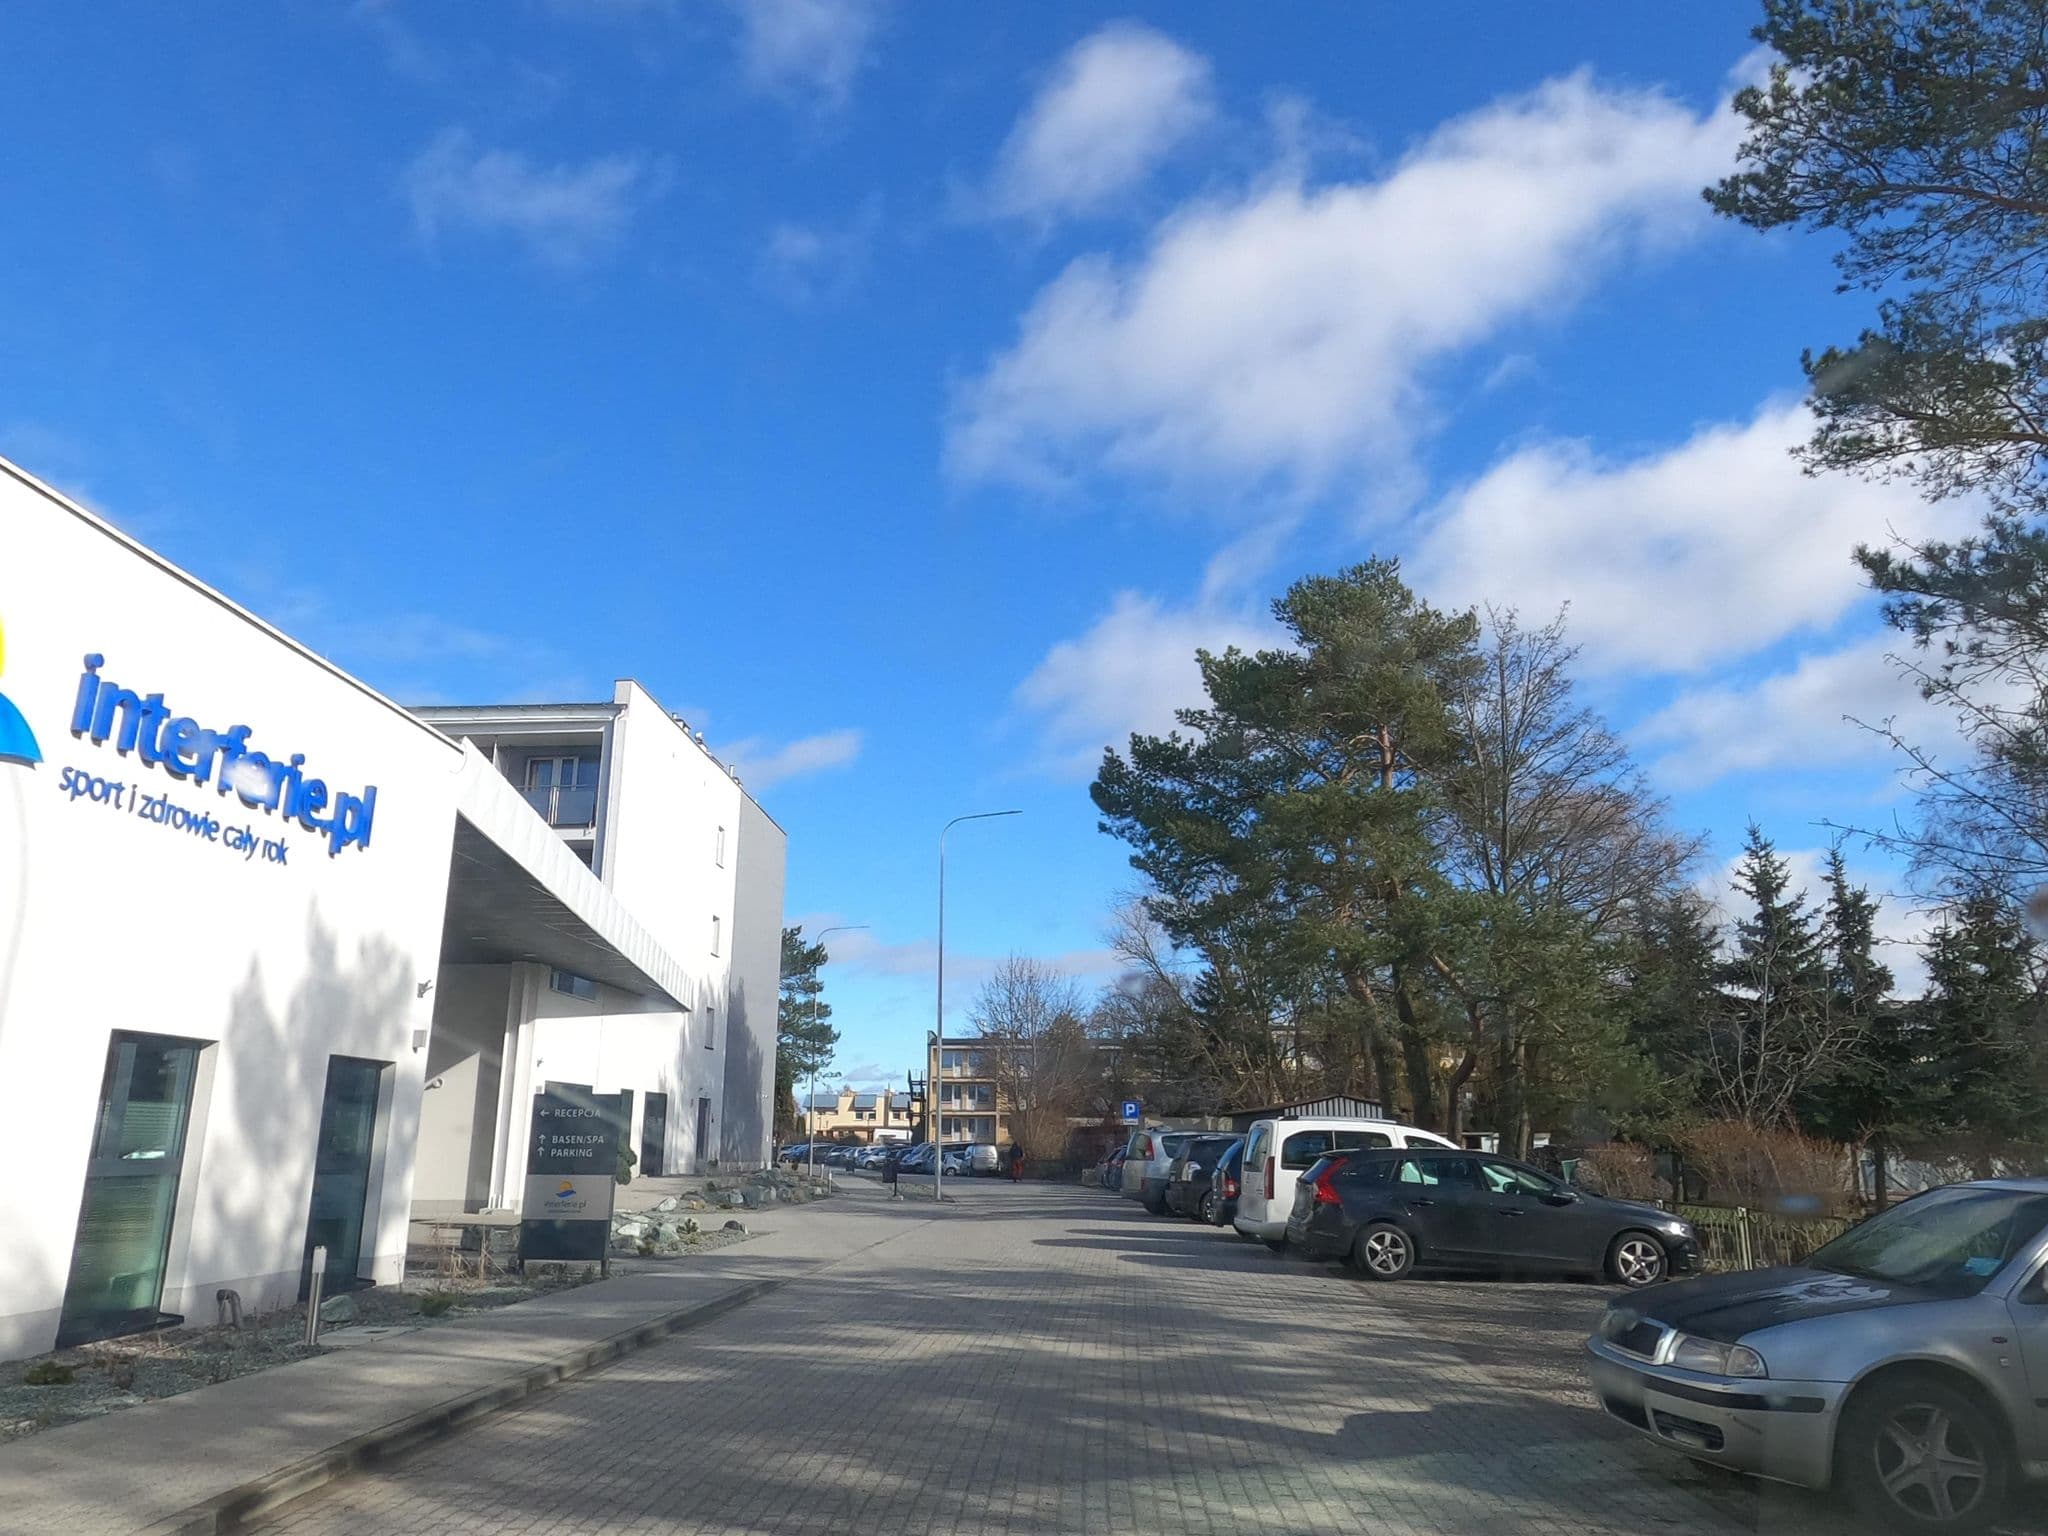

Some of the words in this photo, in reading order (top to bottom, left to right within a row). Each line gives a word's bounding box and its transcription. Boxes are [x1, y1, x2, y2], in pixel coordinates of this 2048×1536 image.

[59, 766, 126, 811] sport
[128, 783, 138, 814] i
[137, 793, 220, 843] zdrowie
[261, 837, 289, 866] rok
[1125, 1103, 1136, 1117] P
[551, 1135, 605, 1144] BASEN/SPA
[550, 1148, 593, 1158] PARKING
